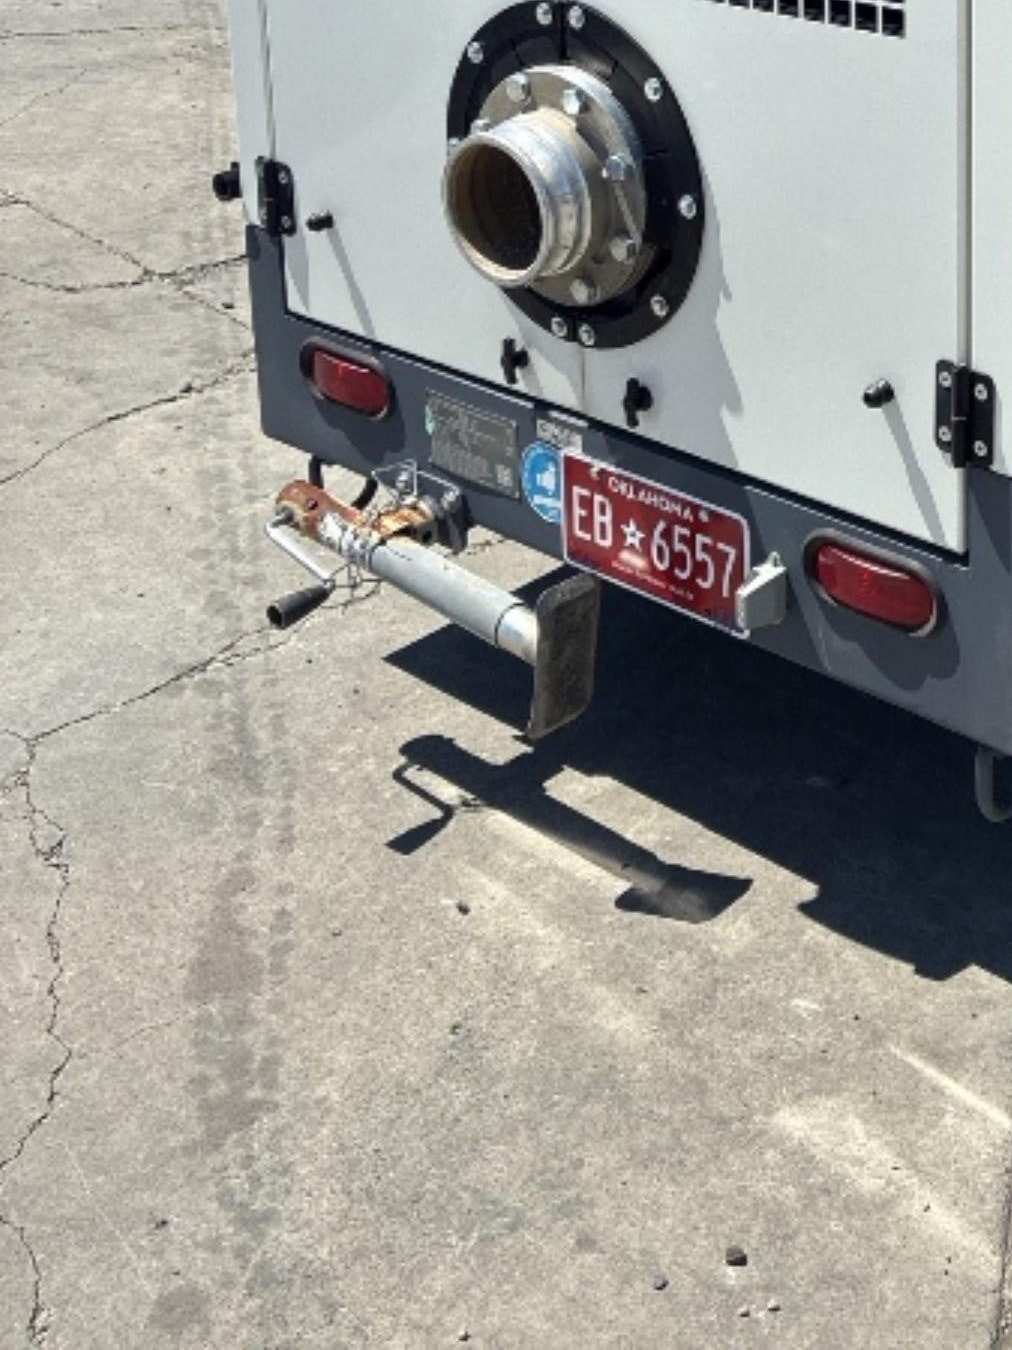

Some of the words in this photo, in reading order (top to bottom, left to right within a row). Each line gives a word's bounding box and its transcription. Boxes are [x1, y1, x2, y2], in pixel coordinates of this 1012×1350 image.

[607, 476, 694, 523] OKLAHOMA
[572, 484, 613, 548] EB
[651, 518, 737, 598] 6557
